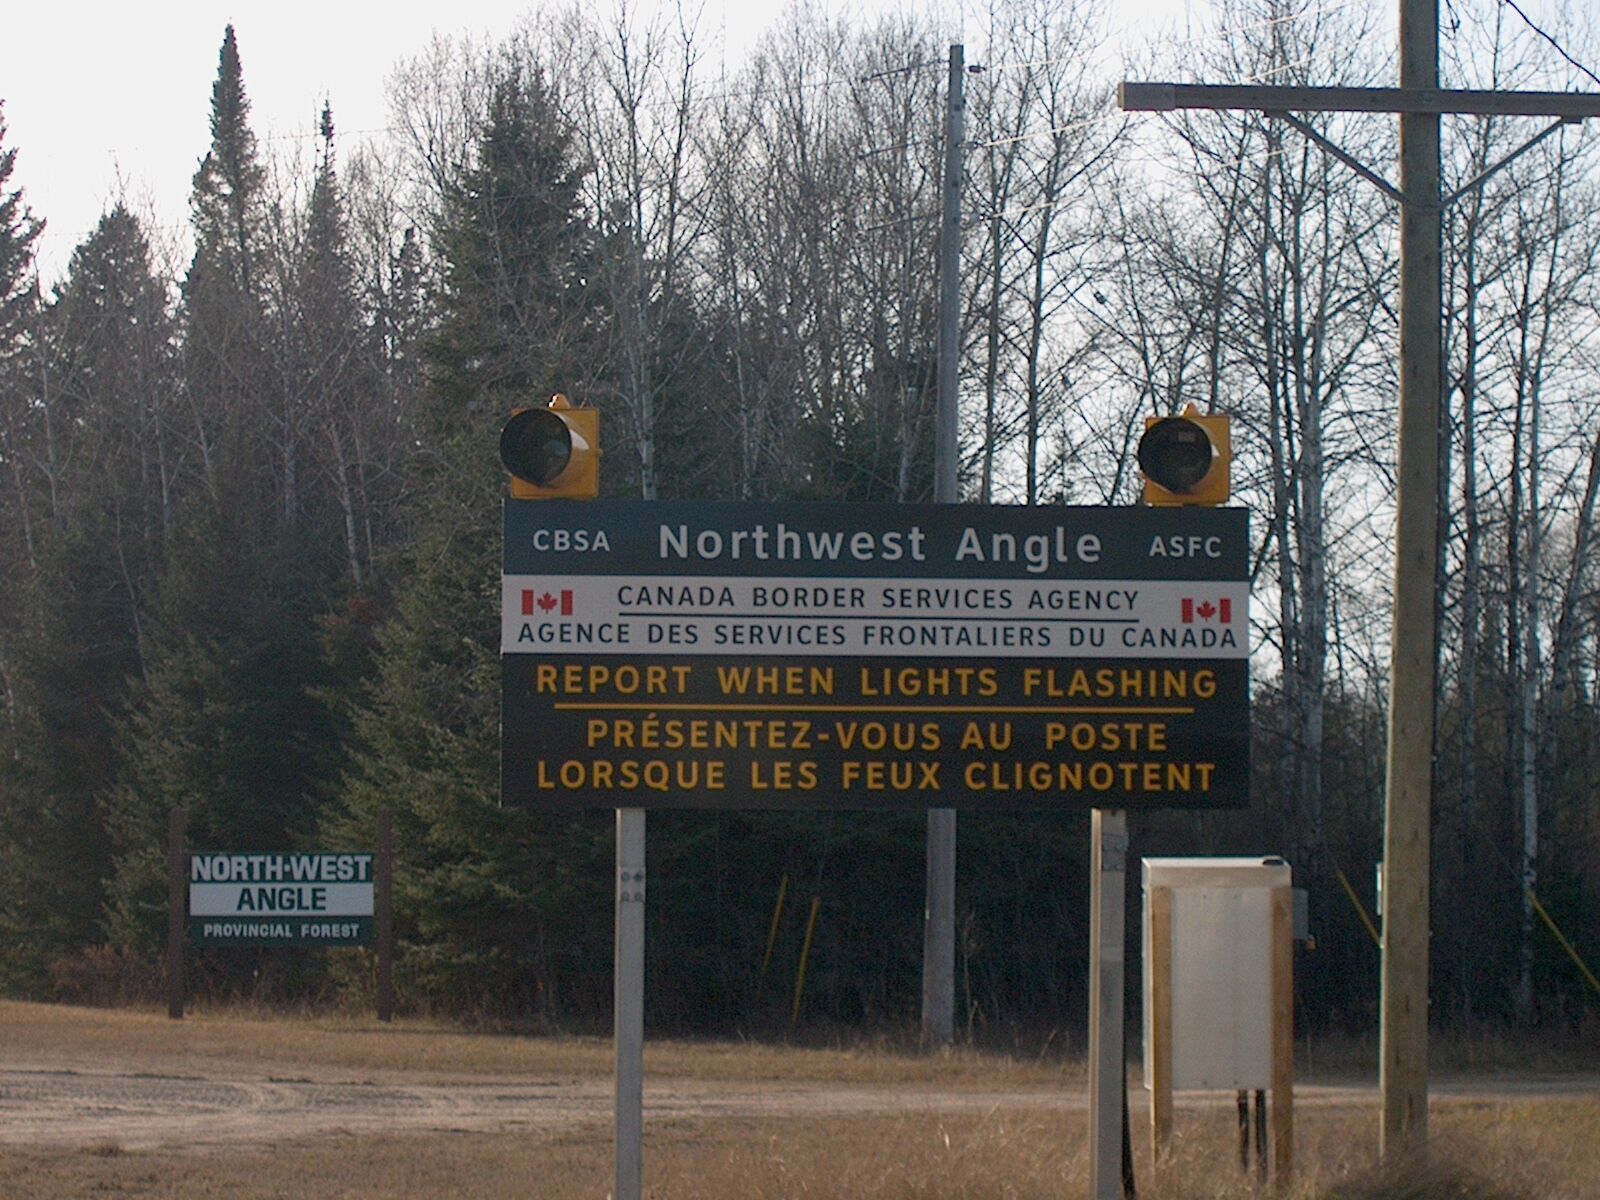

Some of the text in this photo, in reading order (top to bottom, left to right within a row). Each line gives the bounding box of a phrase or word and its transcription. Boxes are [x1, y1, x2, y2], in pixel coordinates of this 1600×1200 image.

[532, 529, 611, 552] CBSA
[659, 524, 1101, 573] Northwest Angle
[1149, 536, 1222, 557] ASFC
[617, 585, 1140, 611] CANADA BORDER SERVICES AGENCY
[518, 623, 1237, 648] AGENCE DES SERVICES FRONTALIERS DU CANADA
[537, 664, 1218, 698] REPORT WHEN LIGHTS FLASHING
[587, 713, 1168, 751] PRÉSENTEZ-VOUS AU POSTE
[537, 760, 1216, 792] LORSQUE LES FEUX CLIGNOTENT
[237, 888, 326, 911] ANGLE
[204, 924, 359, 938] PROVINCIAL FOREST
